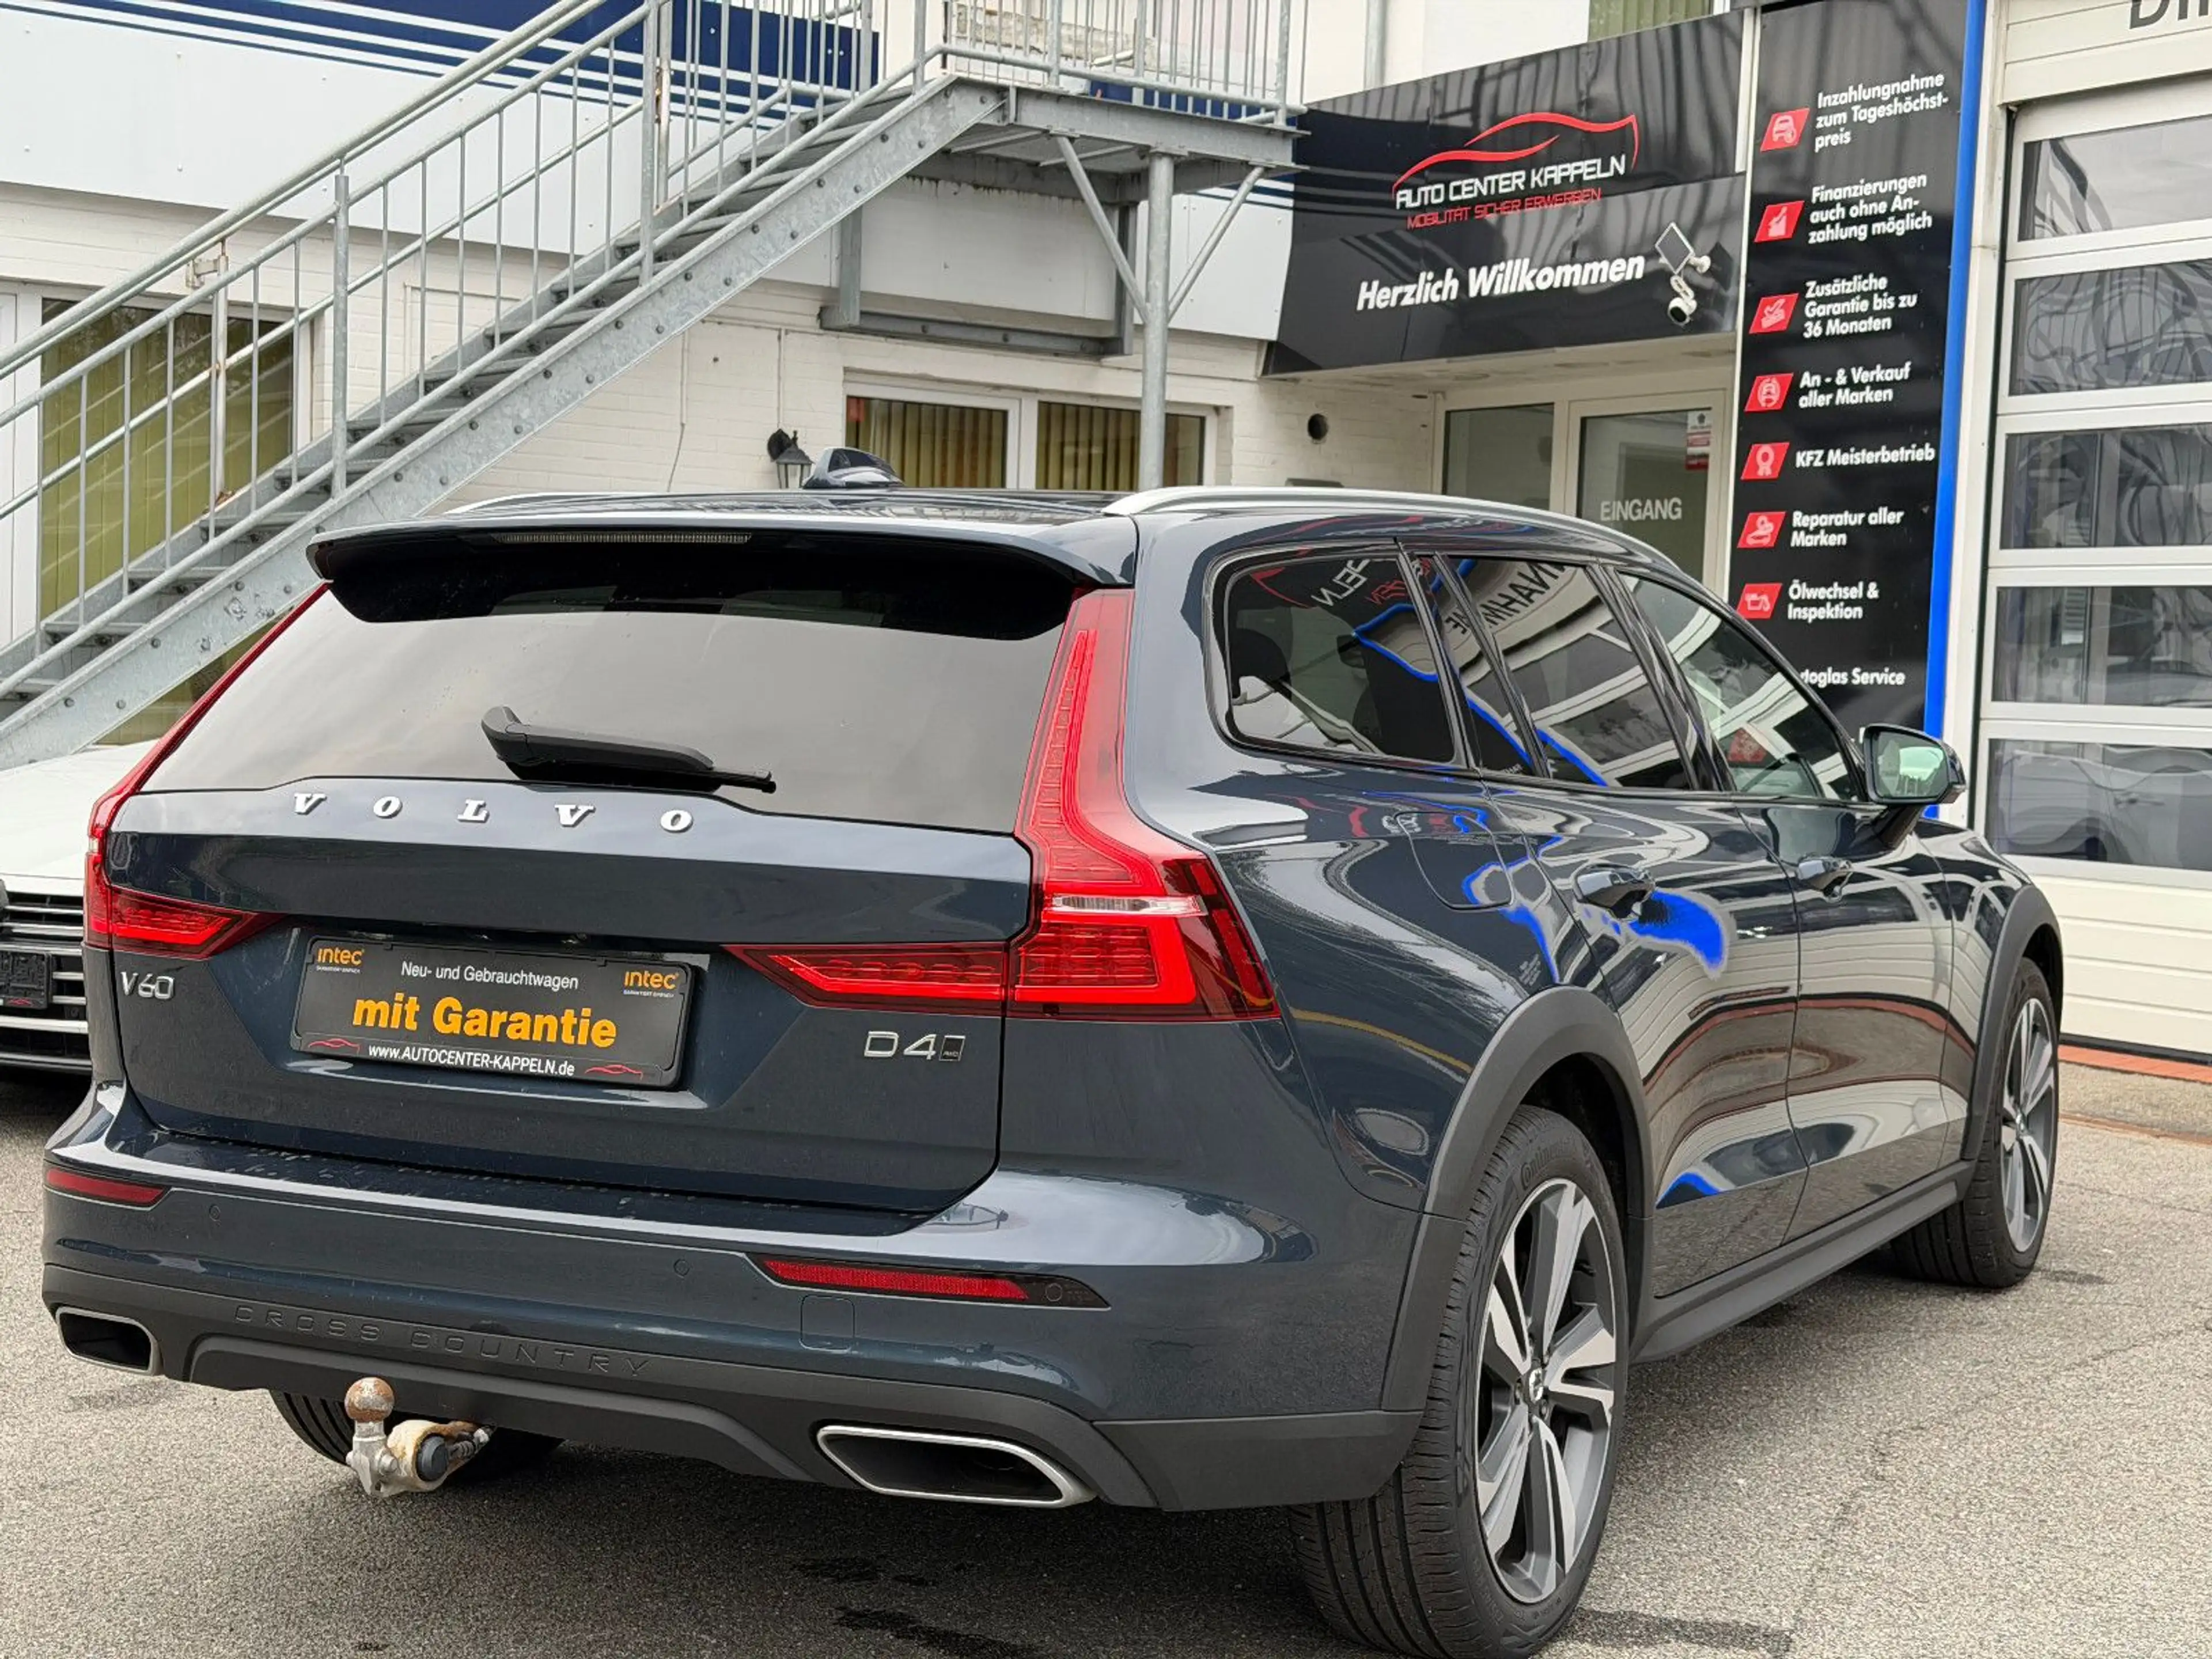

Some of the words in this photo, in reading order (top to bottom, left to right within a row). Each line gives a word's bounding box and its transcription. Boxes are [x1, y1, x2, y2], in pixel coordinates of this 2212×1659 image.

[1818, 73, 1945, 108] Inzahlungnahme
[1816, 113, 1847, 129] zum
[1852, 94, 1949, 123] Tageshöchst-
[1815, 128, 1851, 153] preis
[1396, 183, 1445, 210] AUTO
[1449, 170, 1526, 201] CENTER
[1531, 154, 1626, 189] KAPPELN
[1812, 174, 1927, 203] Finanzierungen
[1810, 202, 1846, 224] auch
[1849, 198, 1888, 218] ohne
[1891, 194, 1920, 211] An-
[1808, 222, 1868, 244] zahlung
[1871, 210, 1933, 237] möglich
[1356, 268, 1458, 311] Herzlich
[1468, 253, 1646, 298] Willkommen
[1805, 272, 1888, 298] Zusätzliche
[1804, 295, 1870, 318] Garantie
[1873, 293, 1895, 312] bis
[1898, 292, 1918, 308] zu
[1803, 322, 1823, 339] 36
[1825, 315, 1892, 336] Monaten
[1835, 368, 1847, 385] &
[1851, 362, 1912, 384] Verkauf
[1798, 390, 1834, 409] aller
[1835, 385, 1893, 404] Marken
[1796, 449, 1824, 468] KFZ
[1826, 442, 1936, 466] Meisterbetrieb
[1600, 497, 1682, 521] EINGANG
[1793, 511, 1864, 531] Reparatur
[1868, 507, 1904, 525] aller
[1790, 529, 1847, 547] Marken
[1789, 579, 1863, 600] Ölwechsel
[1866, 582, 1880, 599] &
[1787, 602, 1863, 623] Inspektion
[1851, 666, 1906, 685] Service
[293, 793, 693, 833] VOLVO
[317, 947, 363, 966] intec
[120, 971, 175, 999] V60
[402, 960, 432, 978] Neu-
[435, 964, 460, 981] und
[463, 965, 579, 990] Gebrauchtwagen
[624, 970, 677, 990] intec
[352, 992, 420, 1029] mit
[432, 997, 617, 1048] Garantie
[864, 1031, 937, 1060] D4
[368, 1043, 575, 1077] www.AUTOCENTER-KAPPELN.de
[234, 1304, 382, 1342] CROSS
[410, 1330, 653, 1377] COUNTRY
